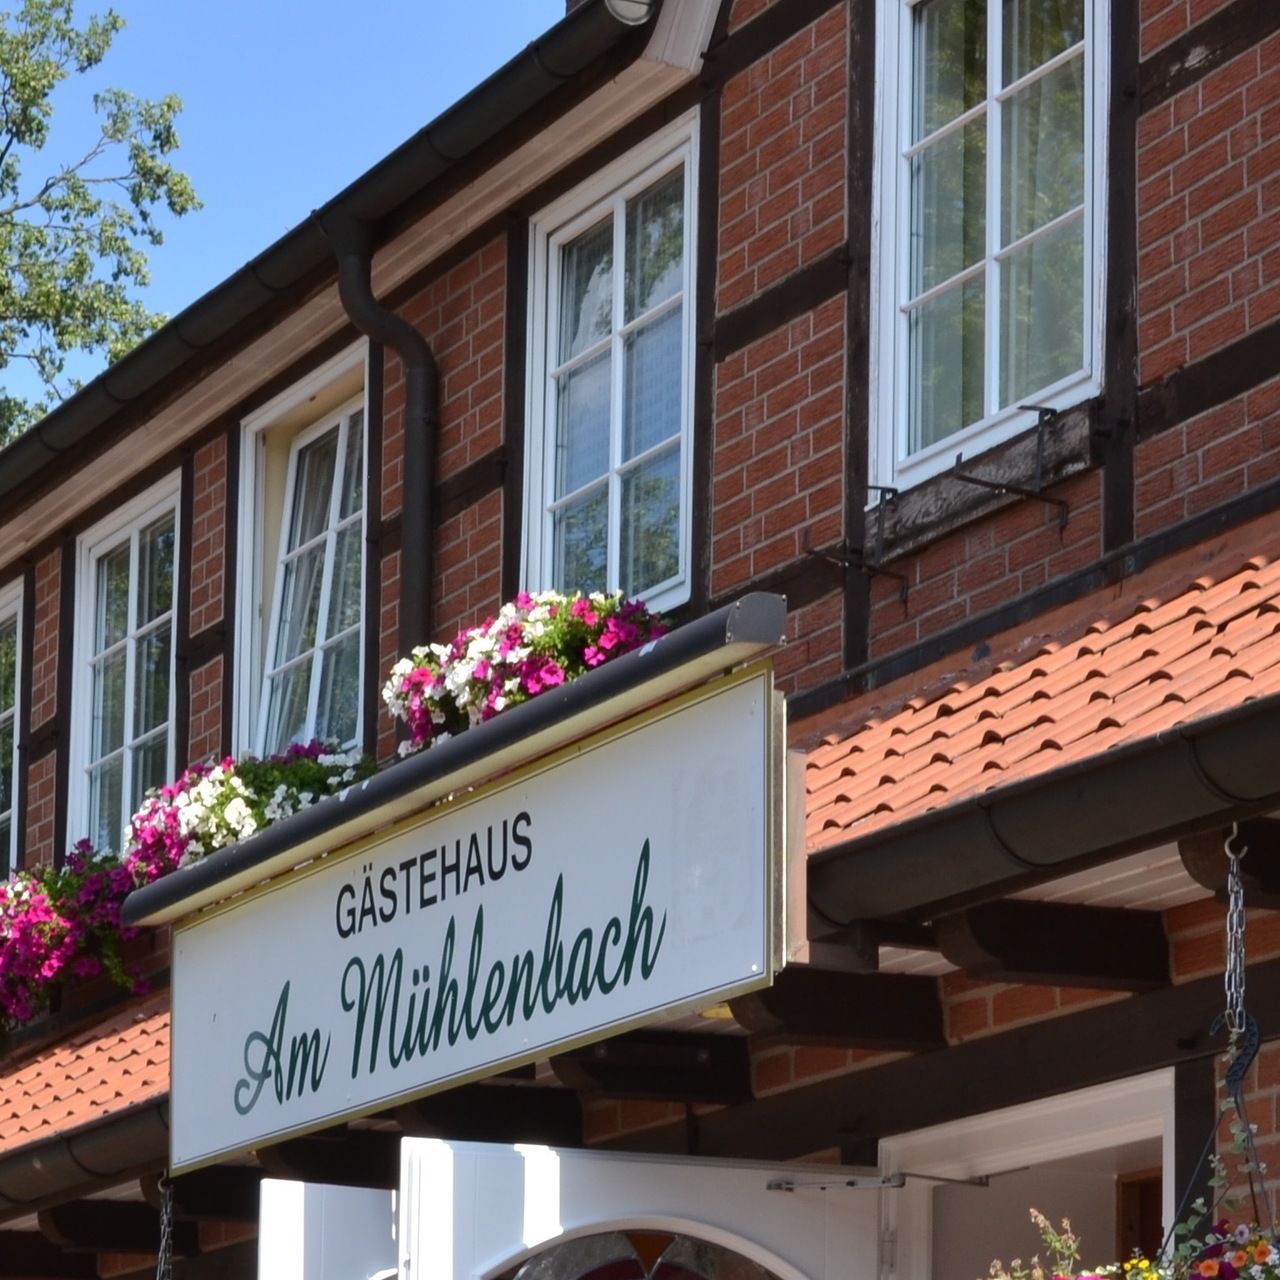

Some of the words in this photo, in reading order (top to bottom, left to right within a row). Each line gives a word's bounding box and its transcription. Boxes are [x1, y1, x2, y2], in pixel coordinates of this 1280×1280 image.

[234, 980, 331, 1116] Am
[341, 838, 667, 1080] Mühlenbach
[335, 811, 533, 940] GÄSTEHAUS
